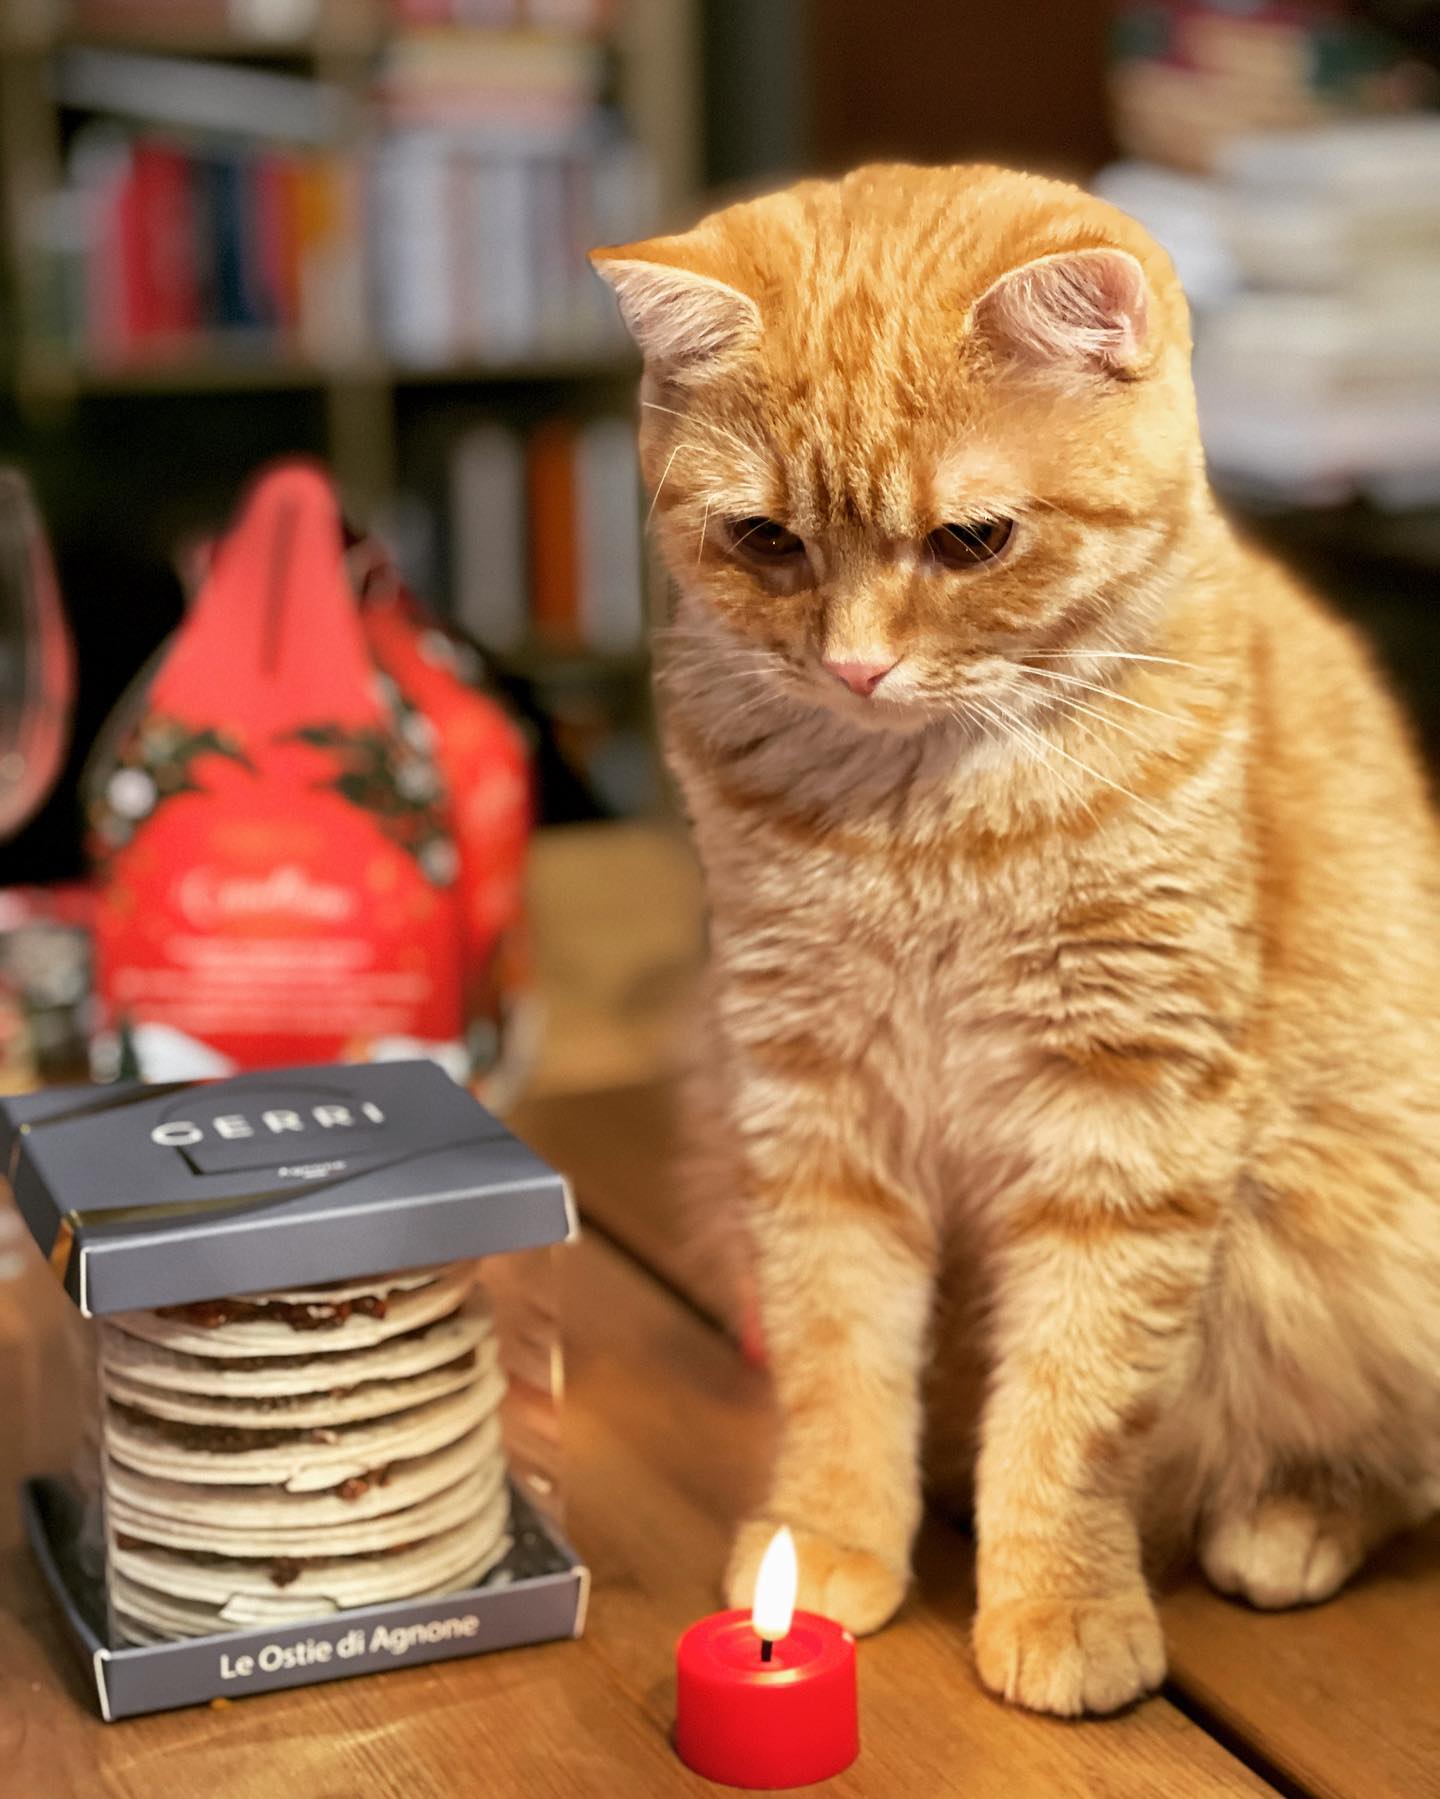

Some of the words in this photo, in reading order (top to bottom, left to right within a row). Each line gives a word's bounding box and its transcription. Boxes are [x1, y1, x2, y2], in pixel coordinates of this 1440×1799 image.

[219, 1654, 254, 1679] Le
[258, 1639, 333, 1672] Ostie
[336, 1629, 366, 1658] di
[369, 1614, 480, 1655] Agnone
